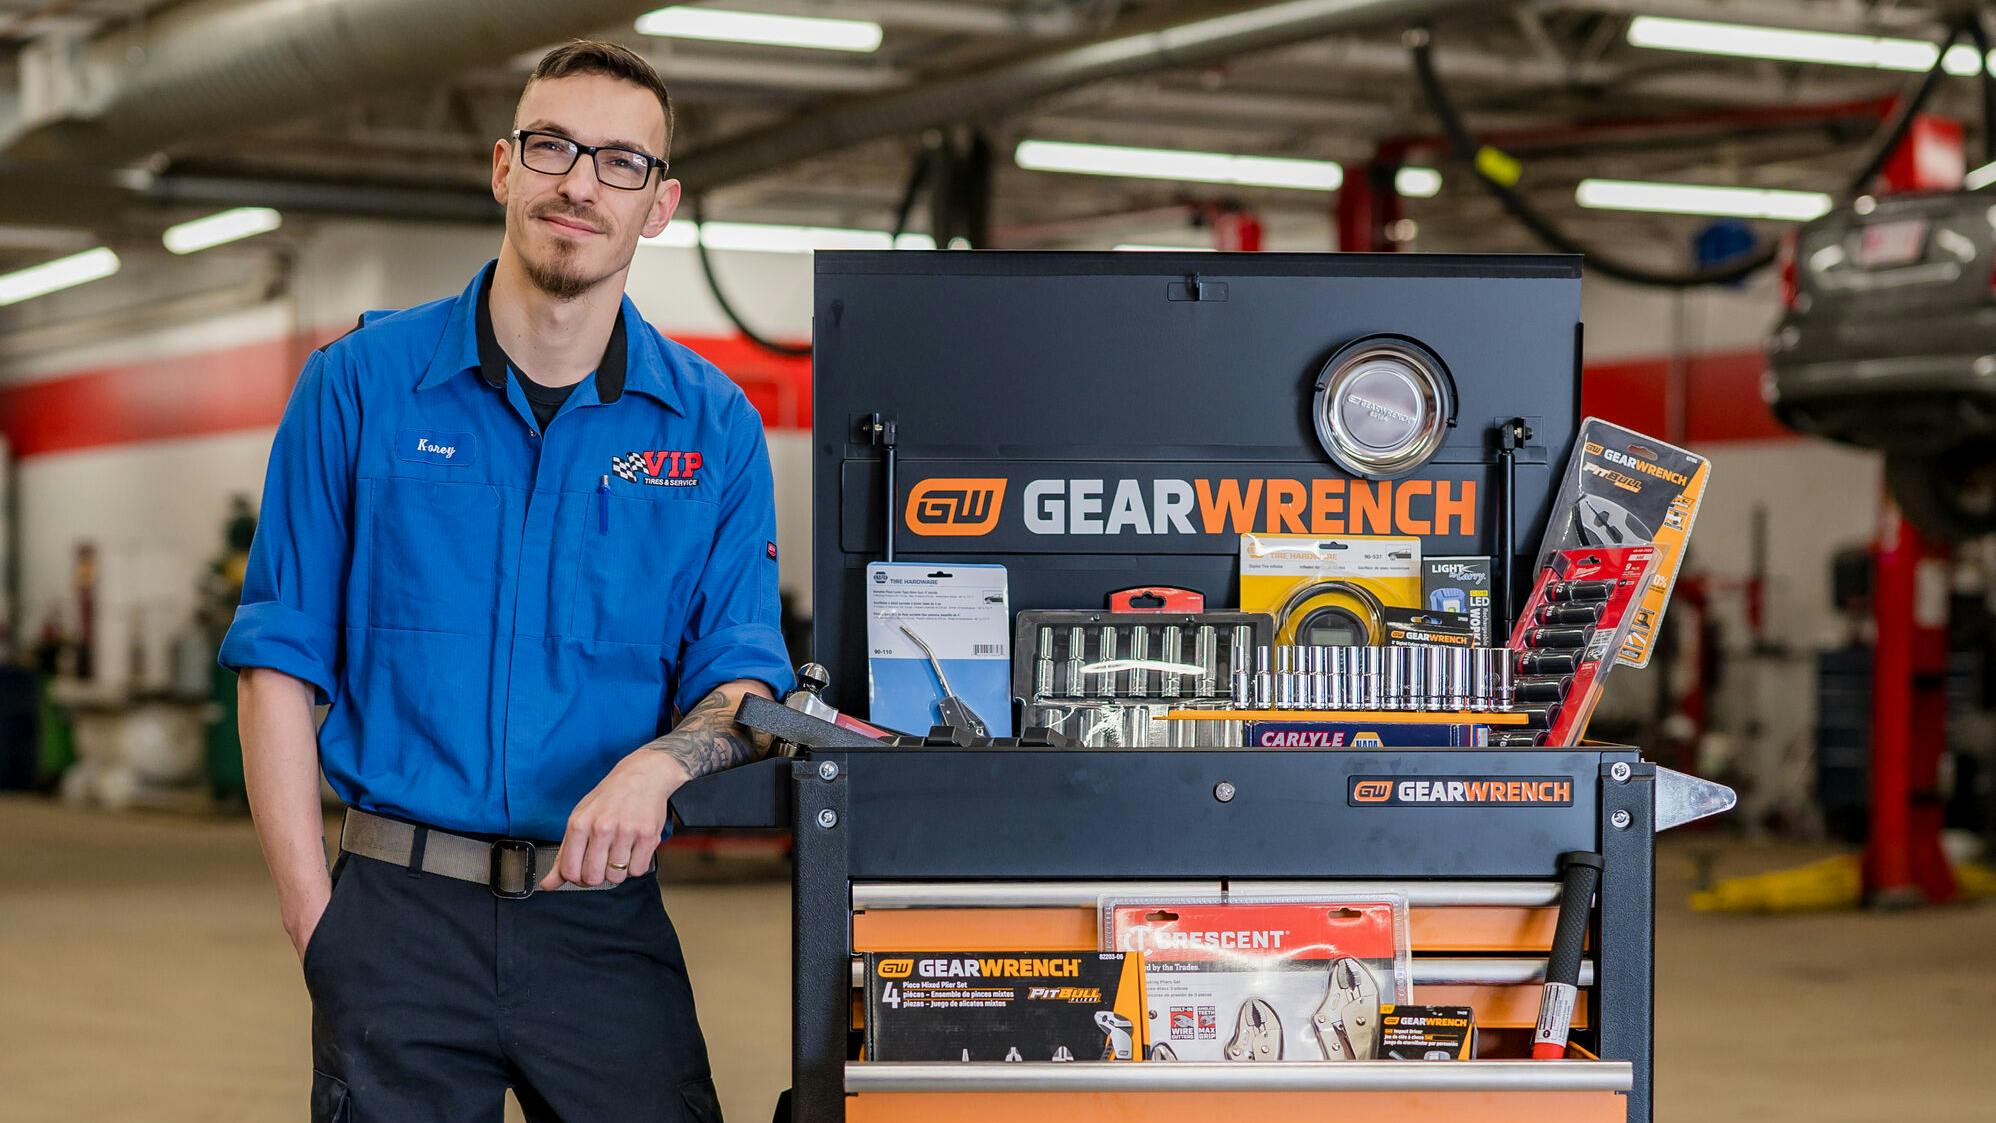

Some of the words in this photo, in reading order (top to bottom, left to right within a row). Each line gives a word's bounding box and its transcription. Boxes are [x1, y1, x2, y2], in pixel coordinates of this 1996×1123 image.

[417, 438, 456, 459] Korey
[642, 451, 703, 478] VIP
[1604, 449, 1688, 487] GEARWRENCH
[644, 477, 664, 486] TIRES
[670, 479, 698, 487] SERVICE
[1023, 478, 1476, 536] GEARWRENCH
[1270, 552, 1288, 560] TIRE
[1431, 564, 1464, 573] LIGHT
[1469, 596, 1490, 607] LED
[1470, 608, 1481, 641] WORK
[1405, 632, 1468, 645] GEARWRENCH
[1261, 731, 1345, 748] CARLYLE
[1398, 781, 1571, 802] GEARWRENCH
[1157, 930, 1286, 949] CRESCENT
[918, 959, 1080, 977] GEARWRENCH
[1152, 963, 1161, 972] by
[1162, 963, 1173, 971] the
[1174, 963, 1200, 971] Trades.
[882, 981, 901, 1009] 4
[930, 990, 961, 998] Ensemble
[962, 990, 971, 998] de
[971, 991, 992, 999] pinces
[992, 990, 1015, 998] mixtes
[1030, 986, 1101, 999] PITBULL
[903, 1000, 925, 1008] piezas
[958, 1000, 984, 1008] alicates
[1400, 1016, 1468, 1027] GEARWRENCH
[1172, 1027, 1194, 1035] WIRE
